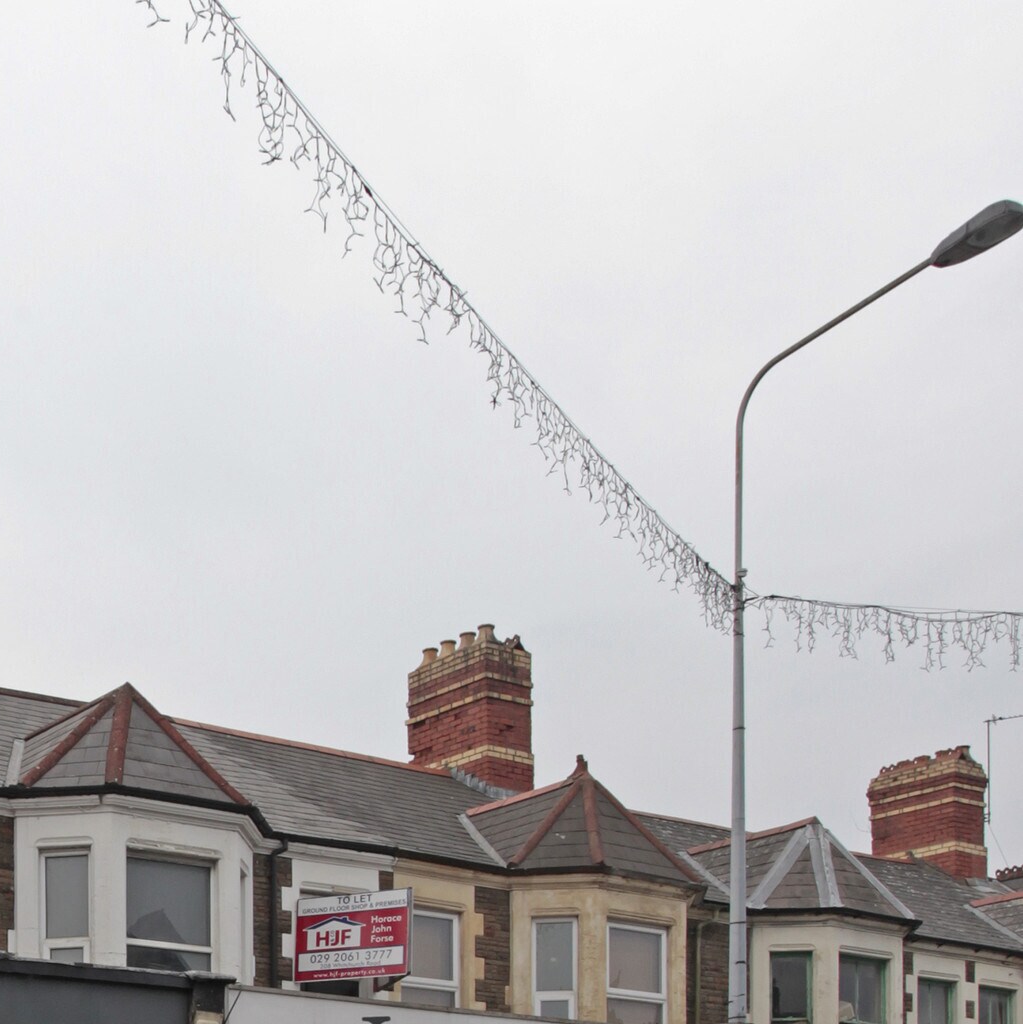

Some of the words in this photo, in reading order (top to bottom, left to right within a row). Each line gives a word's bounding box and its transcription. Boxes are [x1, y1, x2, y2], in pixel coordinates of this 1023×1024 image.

[337, 896, 351, 904] TO
[353, 894, 373, 904] LET
[302, 906, 329, 915] GROUND
[329, 904, 350, 912] FLOOR
[375, 898, 407, 908] PREMISES
[370, 915, 402, 924] Horace
[371, 924, 392, 934] John
[316, 928, 352, 948] HJF
[370, 934, 394, 943] Forse
[309, 953, 330, 964] 029
[333, 951, 360, 962] 2061
[365, 949, 393, 960] 3777
